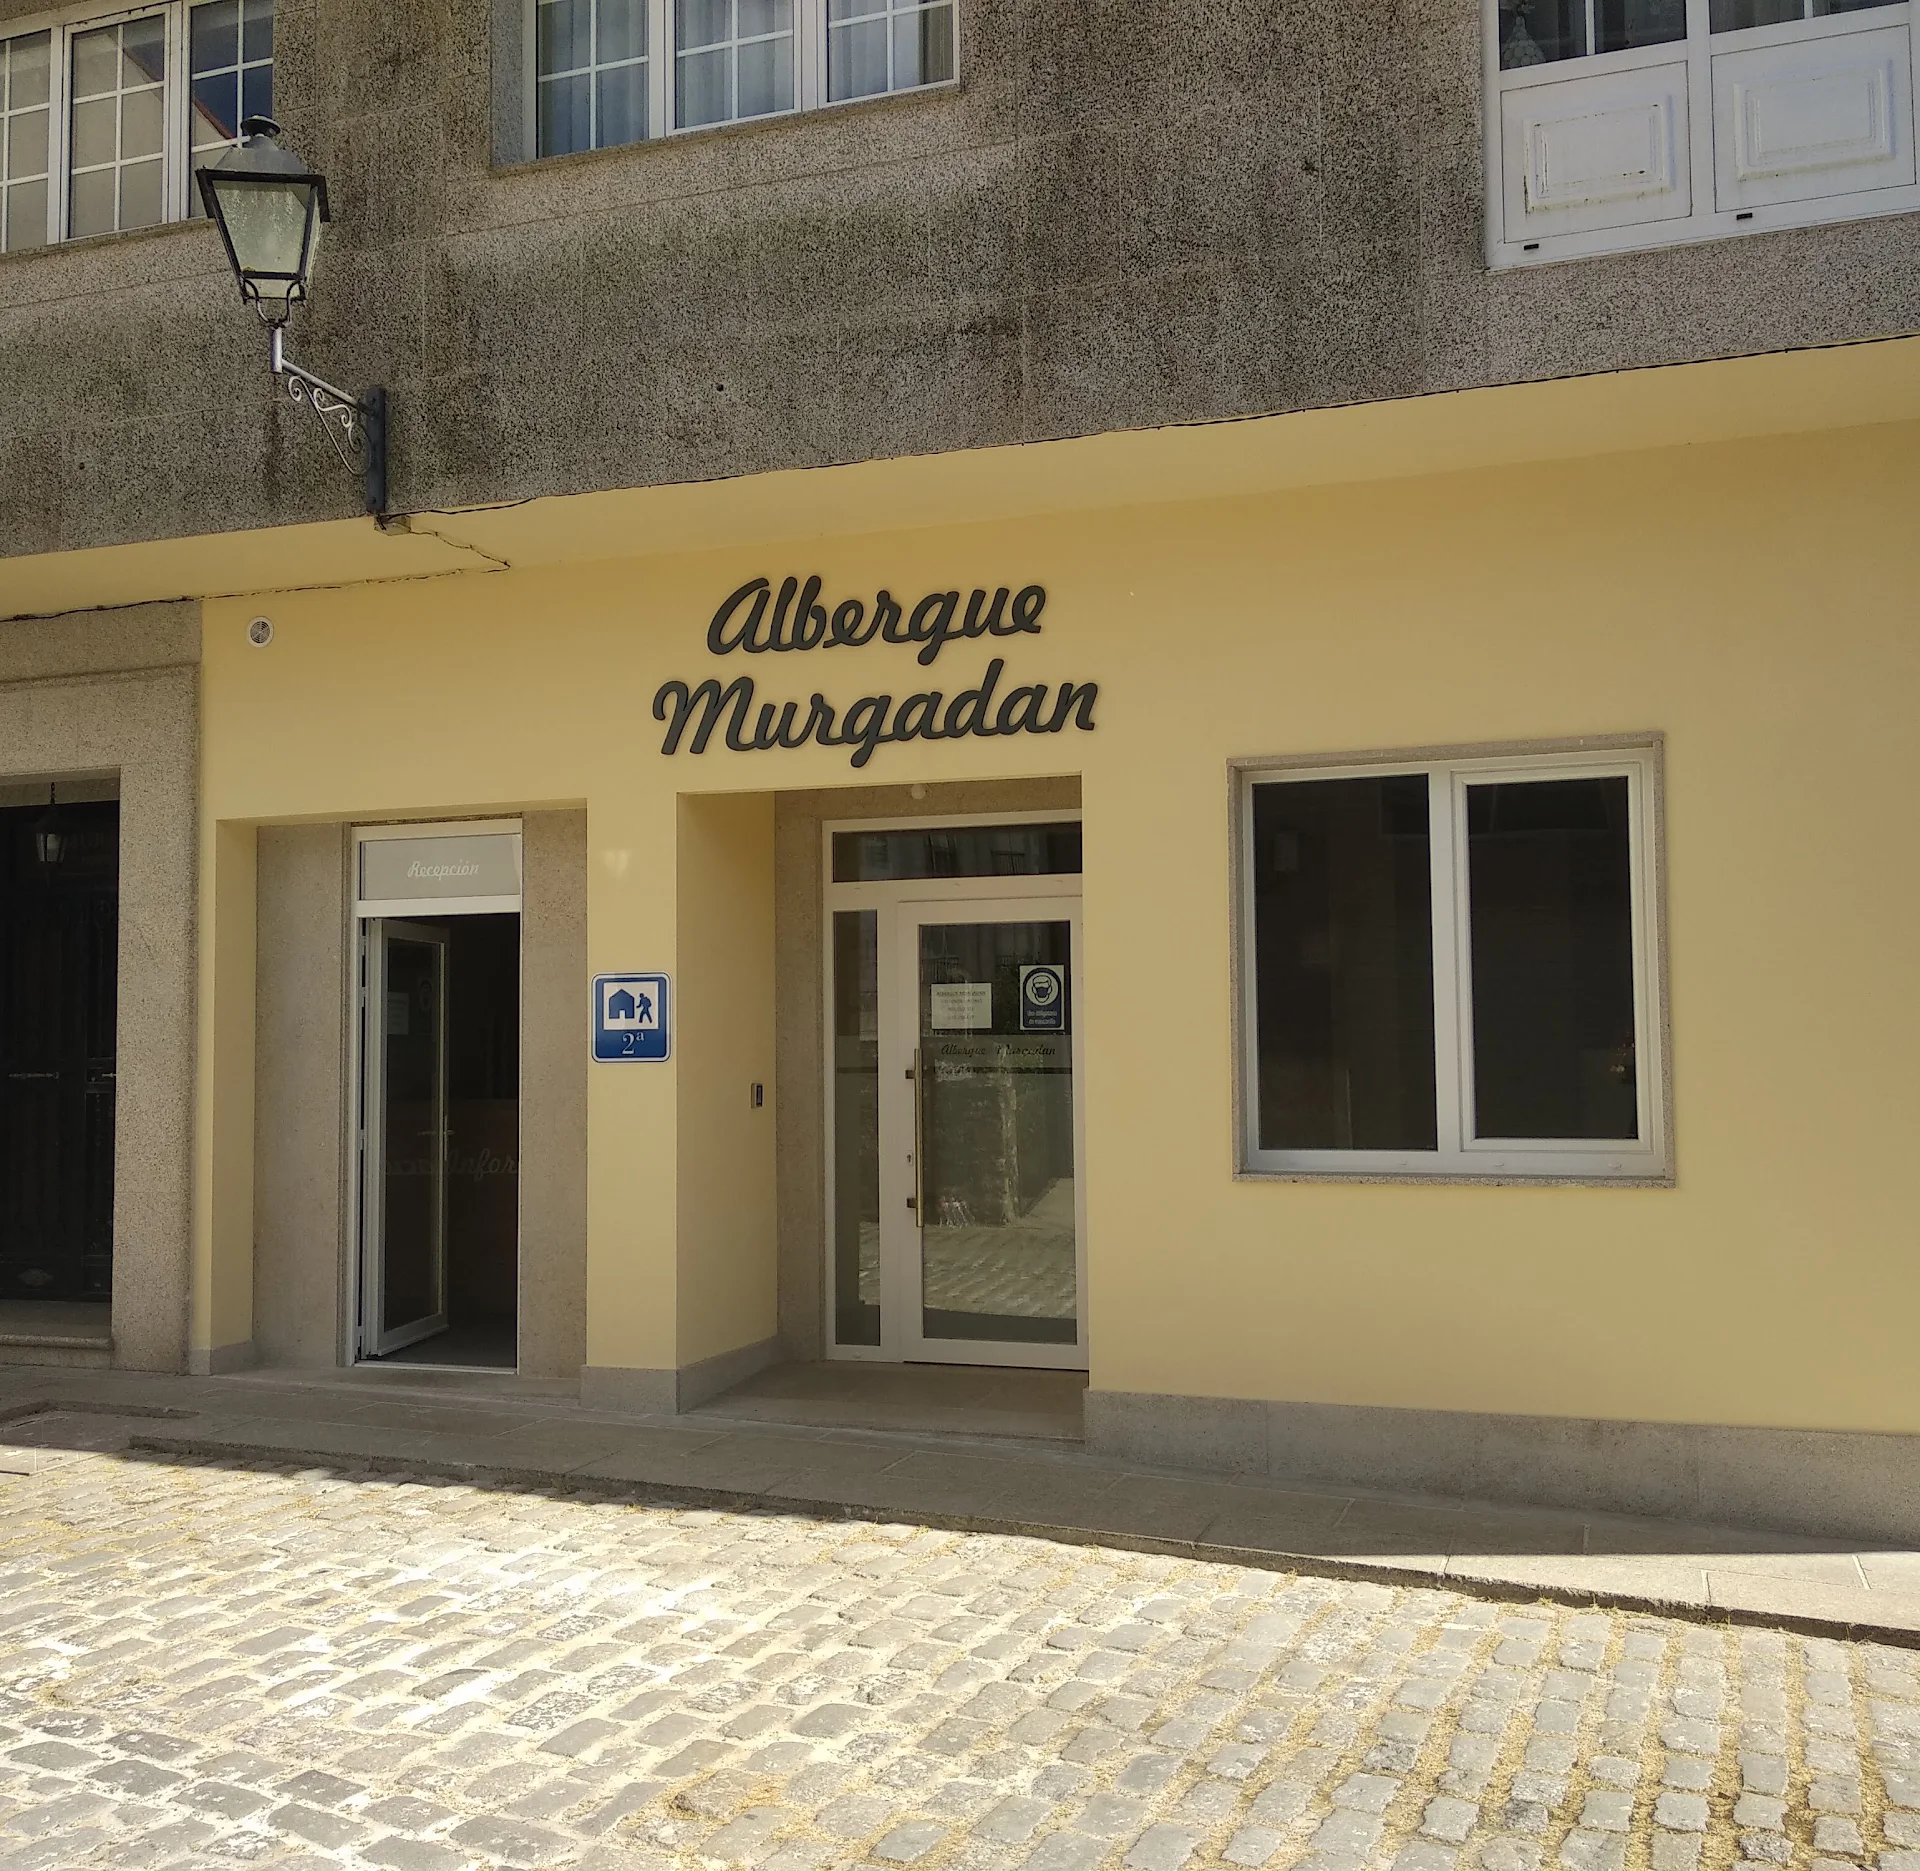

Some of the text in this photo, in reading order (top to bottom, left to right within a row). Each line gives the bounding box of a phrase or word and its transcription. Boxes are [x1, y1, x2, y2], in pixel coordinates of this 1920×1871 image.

[707, 575, 1046, 665] Albergue
[652, 658, 1098, 768] Murgadan
[407, 859, 480, 881] Recepción
